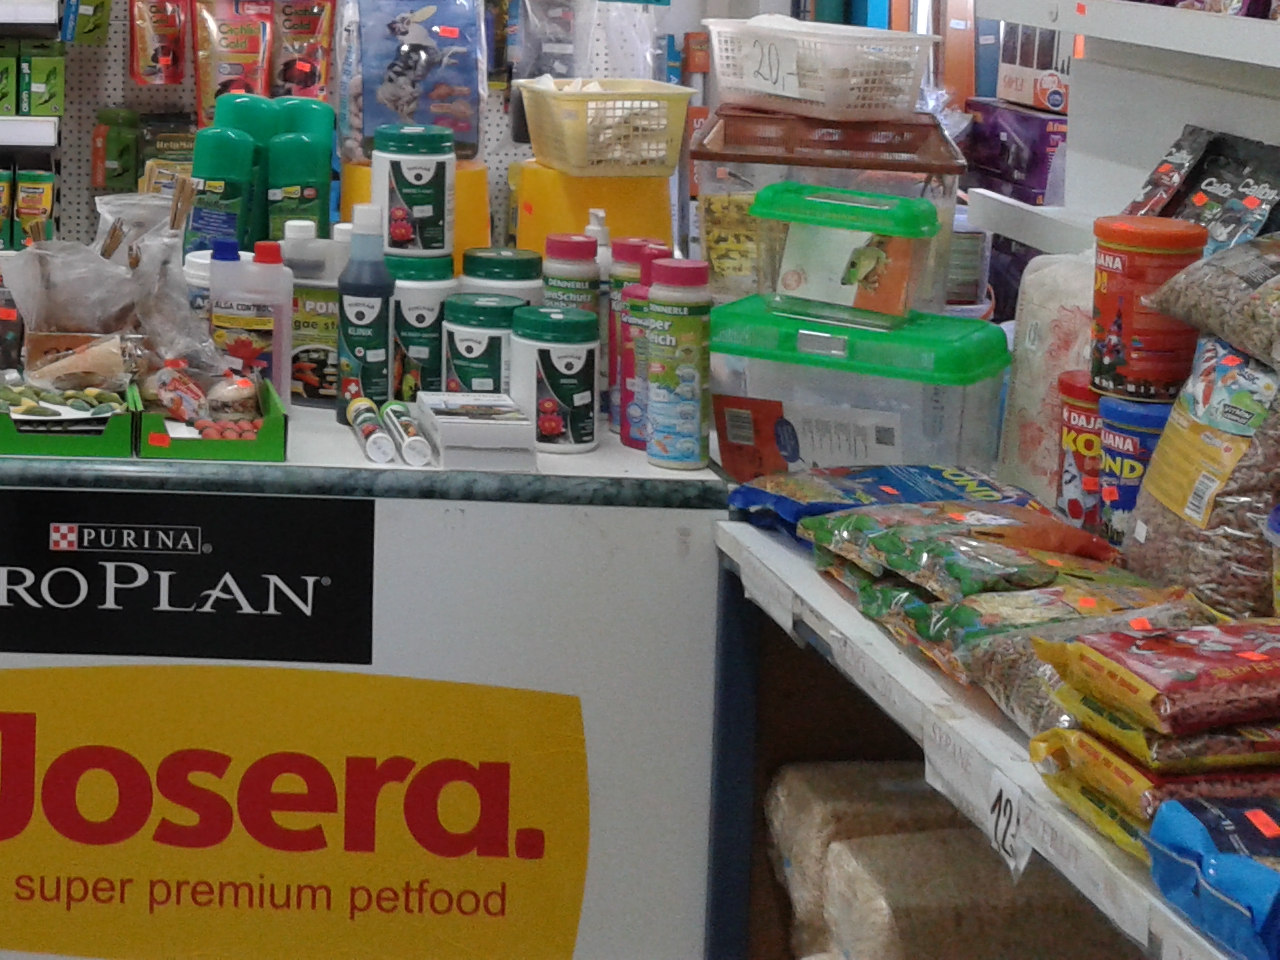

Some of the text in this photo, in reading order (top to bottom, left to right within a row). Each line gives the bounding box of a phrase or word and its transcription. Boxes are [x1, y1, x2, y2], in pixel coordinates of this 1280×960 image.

[81, 528, 196, 552] PURINA
[14, 872, 508, 919] super premium petfood
